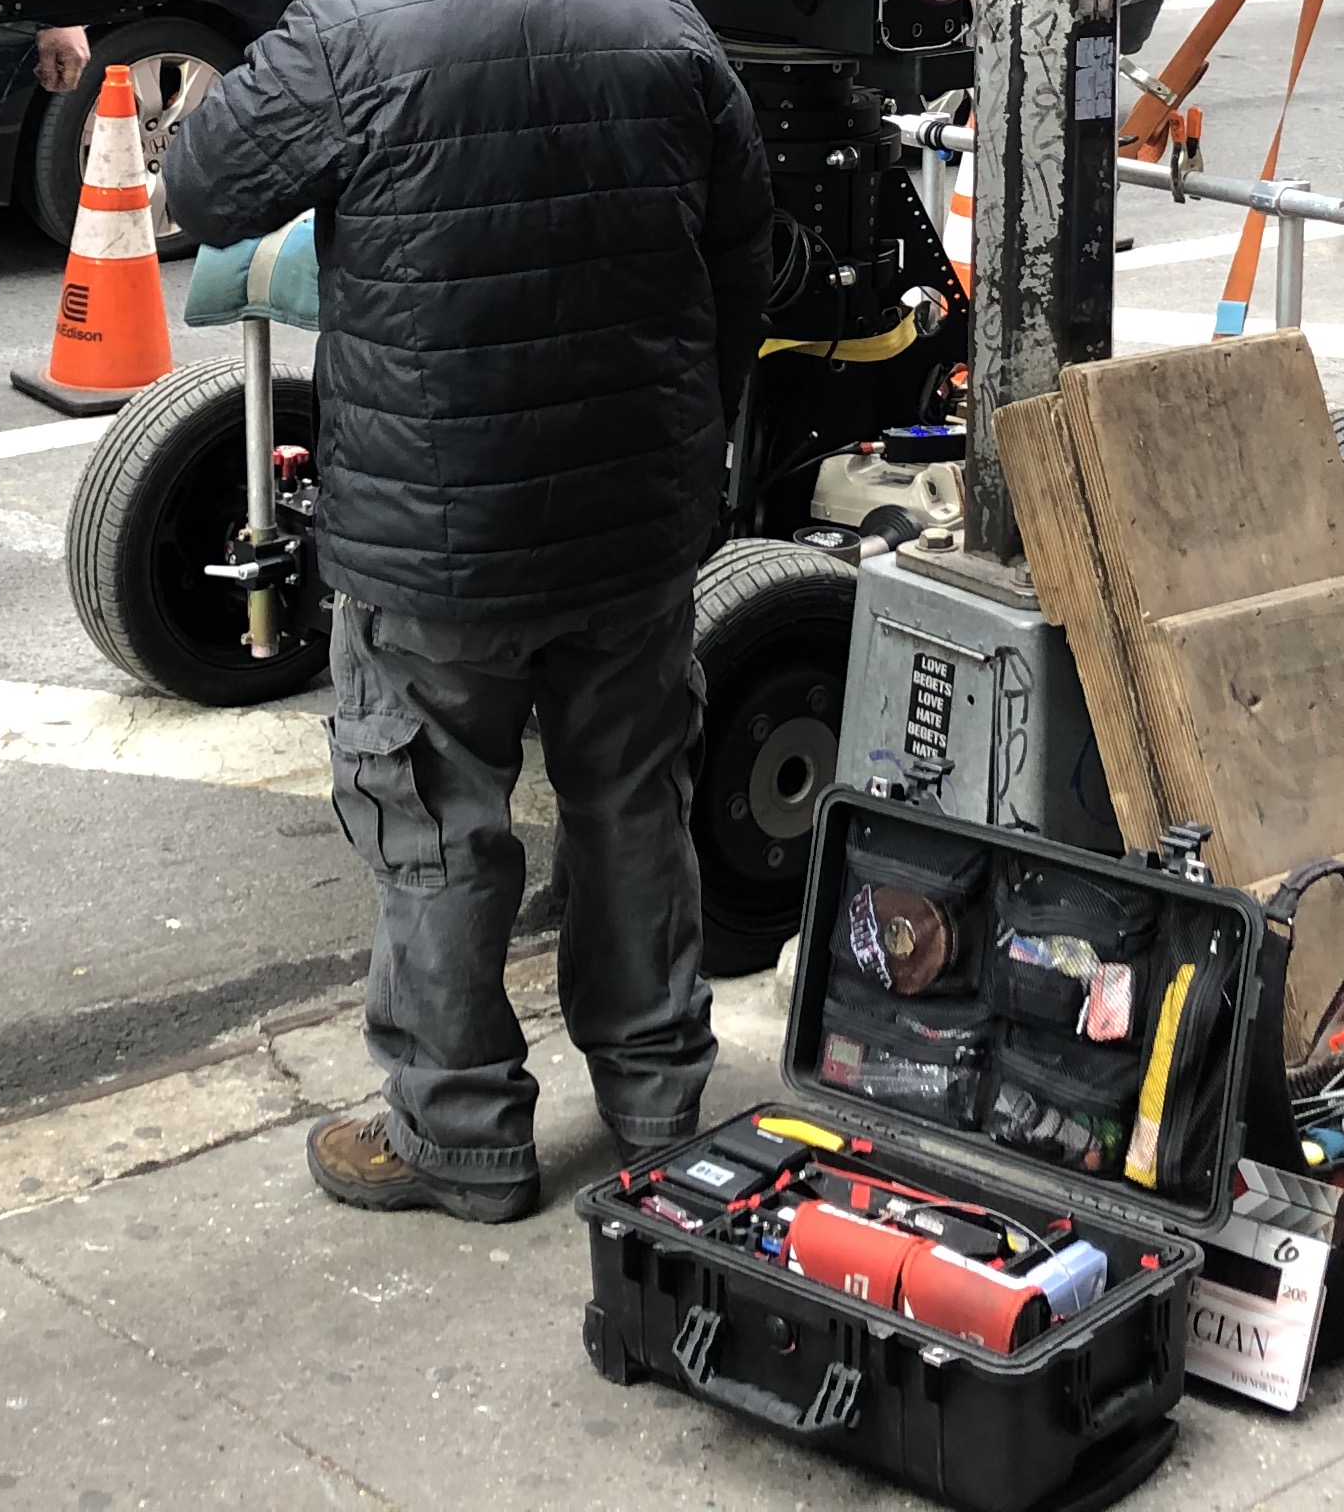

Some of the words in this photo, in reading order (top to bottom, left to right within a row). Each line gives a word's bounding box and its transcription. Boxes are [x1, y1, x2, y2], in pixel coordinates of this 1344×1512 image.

[921, 655, 948, 678] LOVE
[913, 670, 952, 698] BEGETS
[917, 689, 945, 712] LOVE
[916, 706, 943, 729] HATE
[907, 720, 947, 749] BEGETS
[912, 740, 939, 759] HATE
